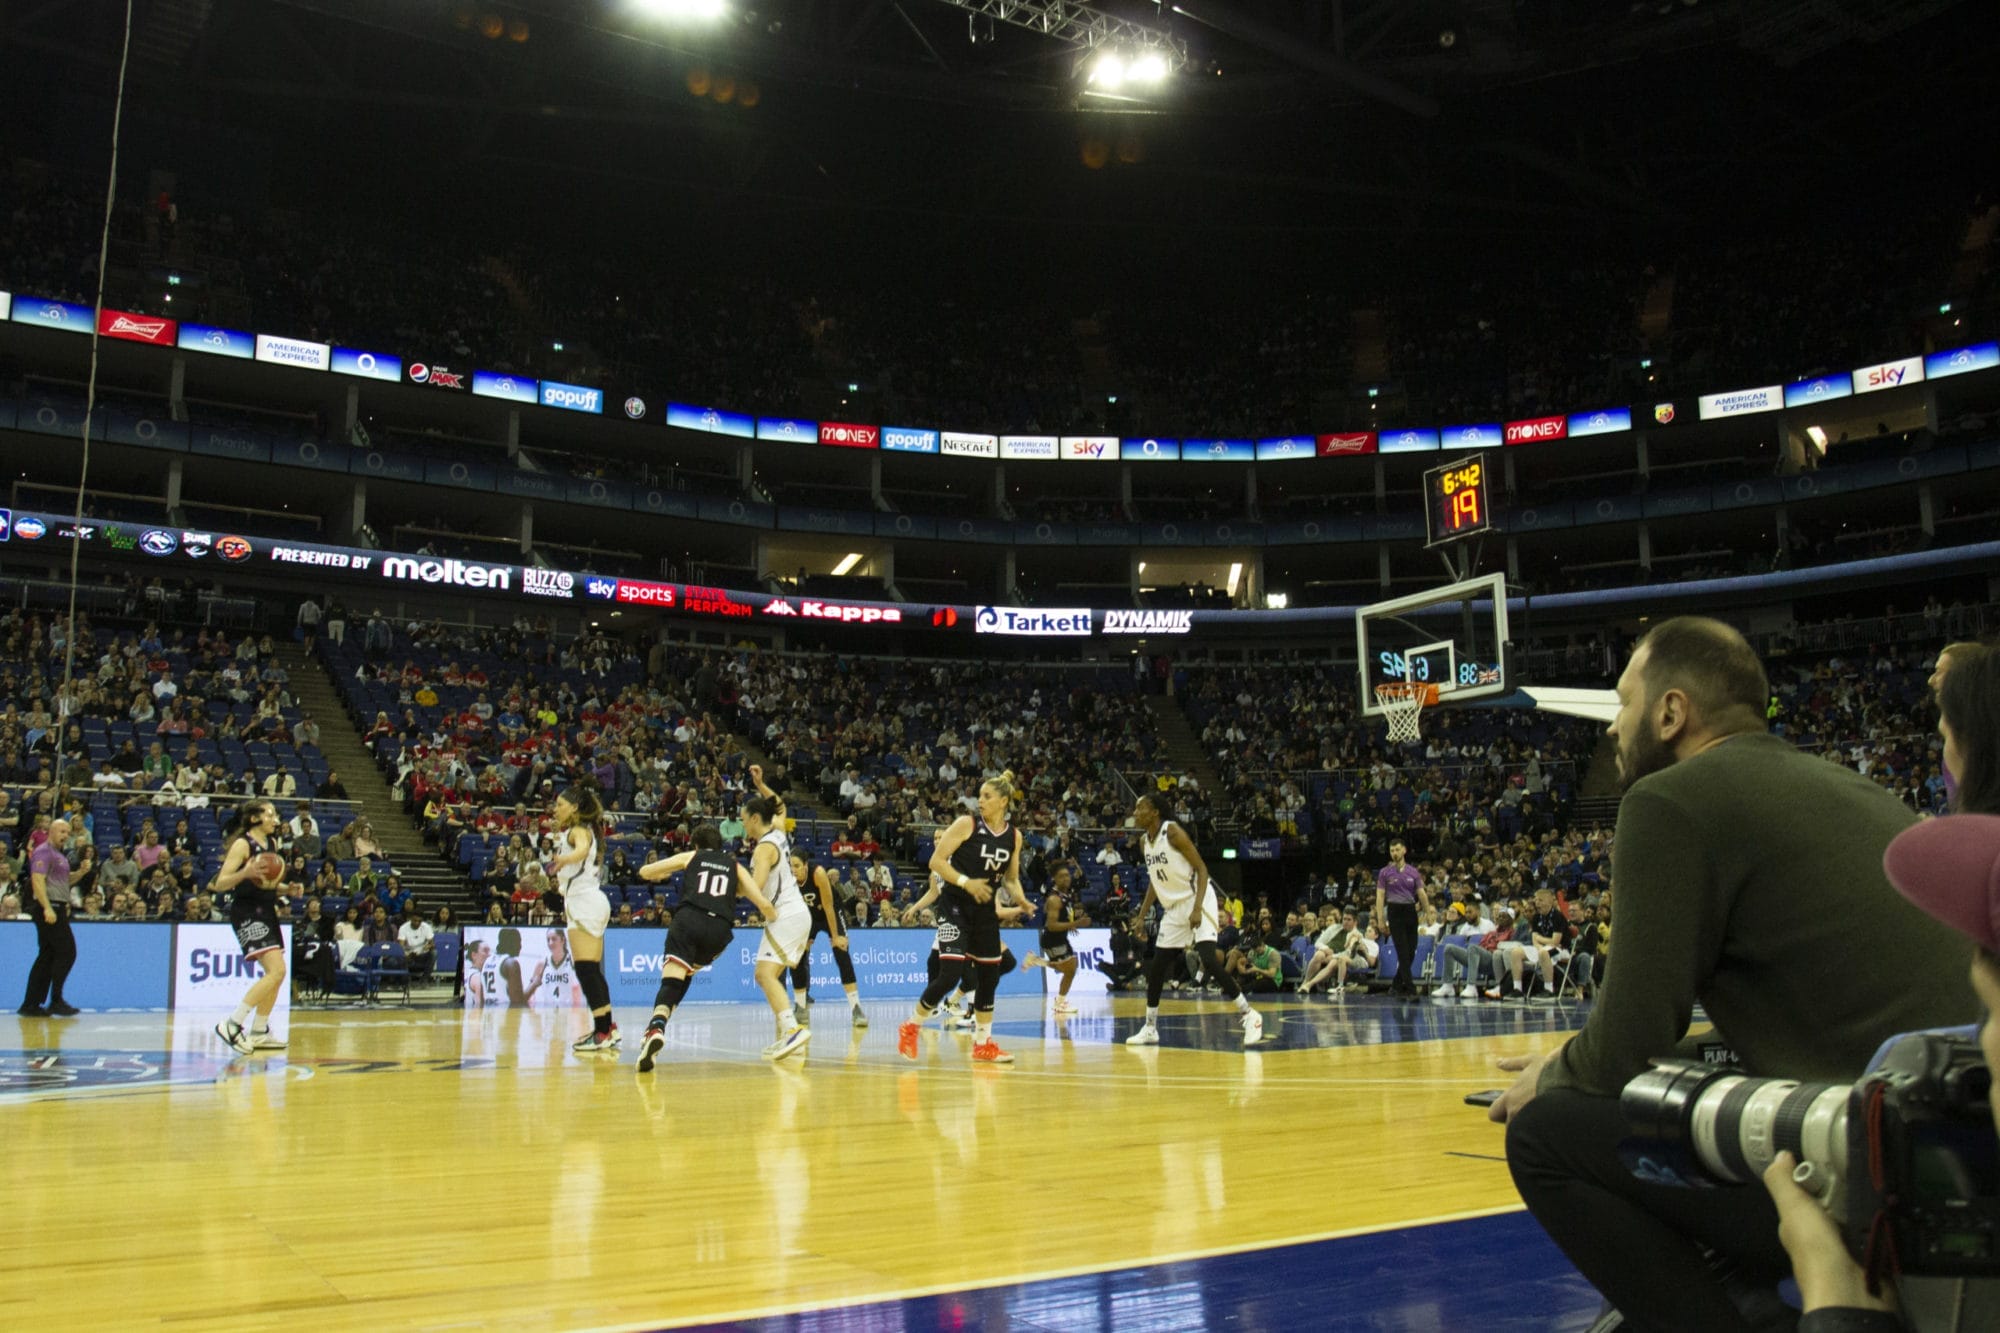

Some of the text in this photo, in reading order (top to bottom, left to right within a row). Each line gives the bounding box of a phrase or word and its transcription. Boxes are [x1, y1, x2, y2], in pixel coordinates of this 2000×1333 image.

[266, 342, 320, 356] AMERICAN
[273, 351, 320, 365] EXPRESS
[1868, 366, 1906, 386] sky
[544, 387, 598, 411] gopuff
[1714, 392, 1767, 407] AMERICAN
[1722, 399, 1768, 413] EXPRESS
[821, 426, 876, 444] MONEY
[1507, 420, 1563, 440] MONEY
[885, 432, 935, 451] gopuff
[1073, 439, 1105, 458] sky
[1442, 464, 1481, 495] 6:42
[1452, 488, 1479, 530] 19
[271, 546, 371, 570] PRESENTED BY
[383, 556, 511, 589] molten
[523, 568, 557, 588] BUZZ
[523, 585, 573, 598] PRODUCTIONS
[588, 580, 672, 603] sky sports
[684, 585, 726, 601] STATS
[684, 599, 752, 617] PERFORM
[801, 600, 901, 623] Kappa
[1004, 610, 1091, 631] Tarkett
[1103, 610, 1193, 630] DYNAMIK
[697, 870, 729, 897] 10
[1156, 869, 1169, 882] 41
[853, 947, 918, 964] solicitors
[189, 948, 264, 984] SUN
[483, 971, 496, 993] 12
[545, 973, 569, 984] SUNS
[877, 973, 904, 983] 01732
[553, 986, 560, 998] 4
